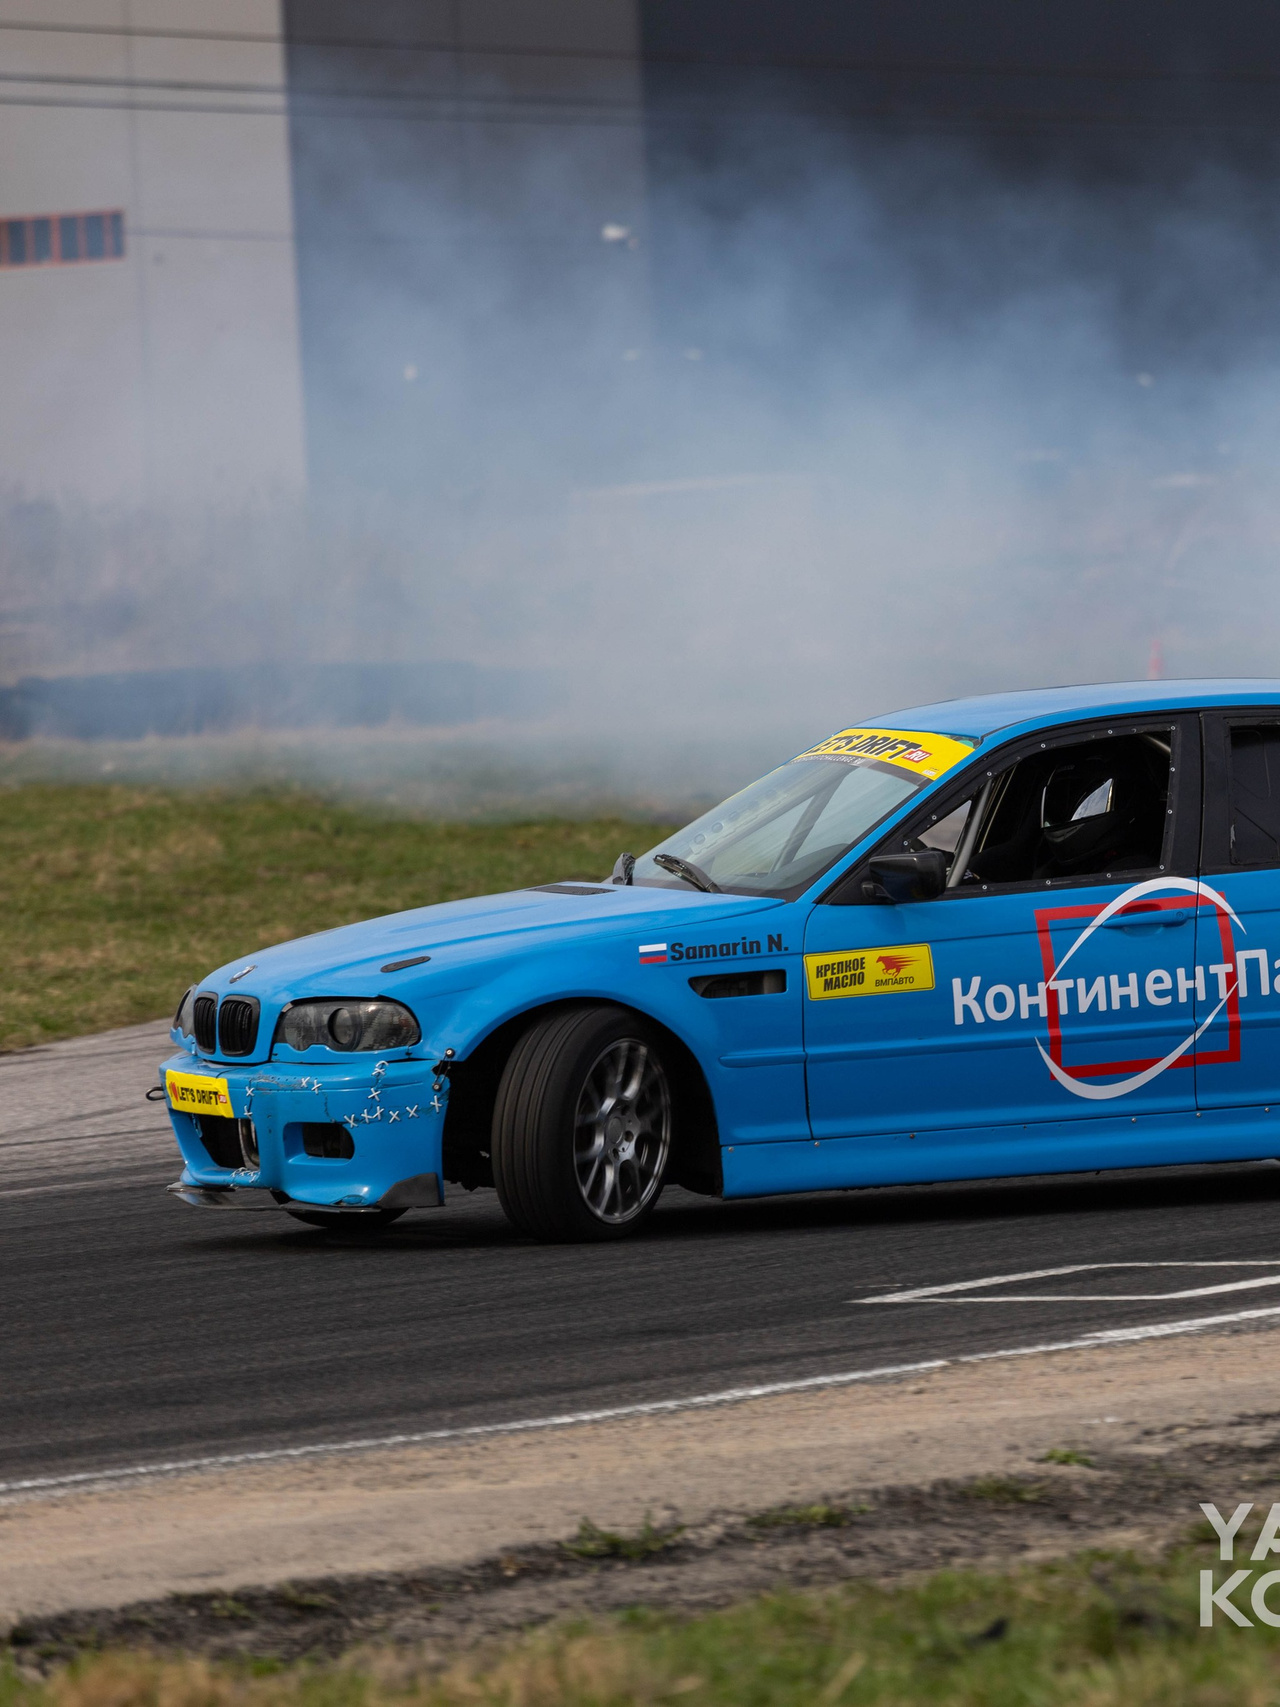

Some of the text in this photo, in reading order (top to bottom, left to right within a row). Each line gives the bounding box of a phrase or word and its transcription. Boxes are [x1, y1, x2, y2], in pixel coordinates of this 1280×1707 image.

[845, 735, 923, 760] DRIFT
[670, 933, 789, 961] Samarin N.
[816, 956, 866, 979] КРЕПКОЕ
[823, 971, 865, 992] МАСЛО
[875, 976, 915, 987] ВМПАВТО
[196, 1089, 218, 1106] DRIFT
